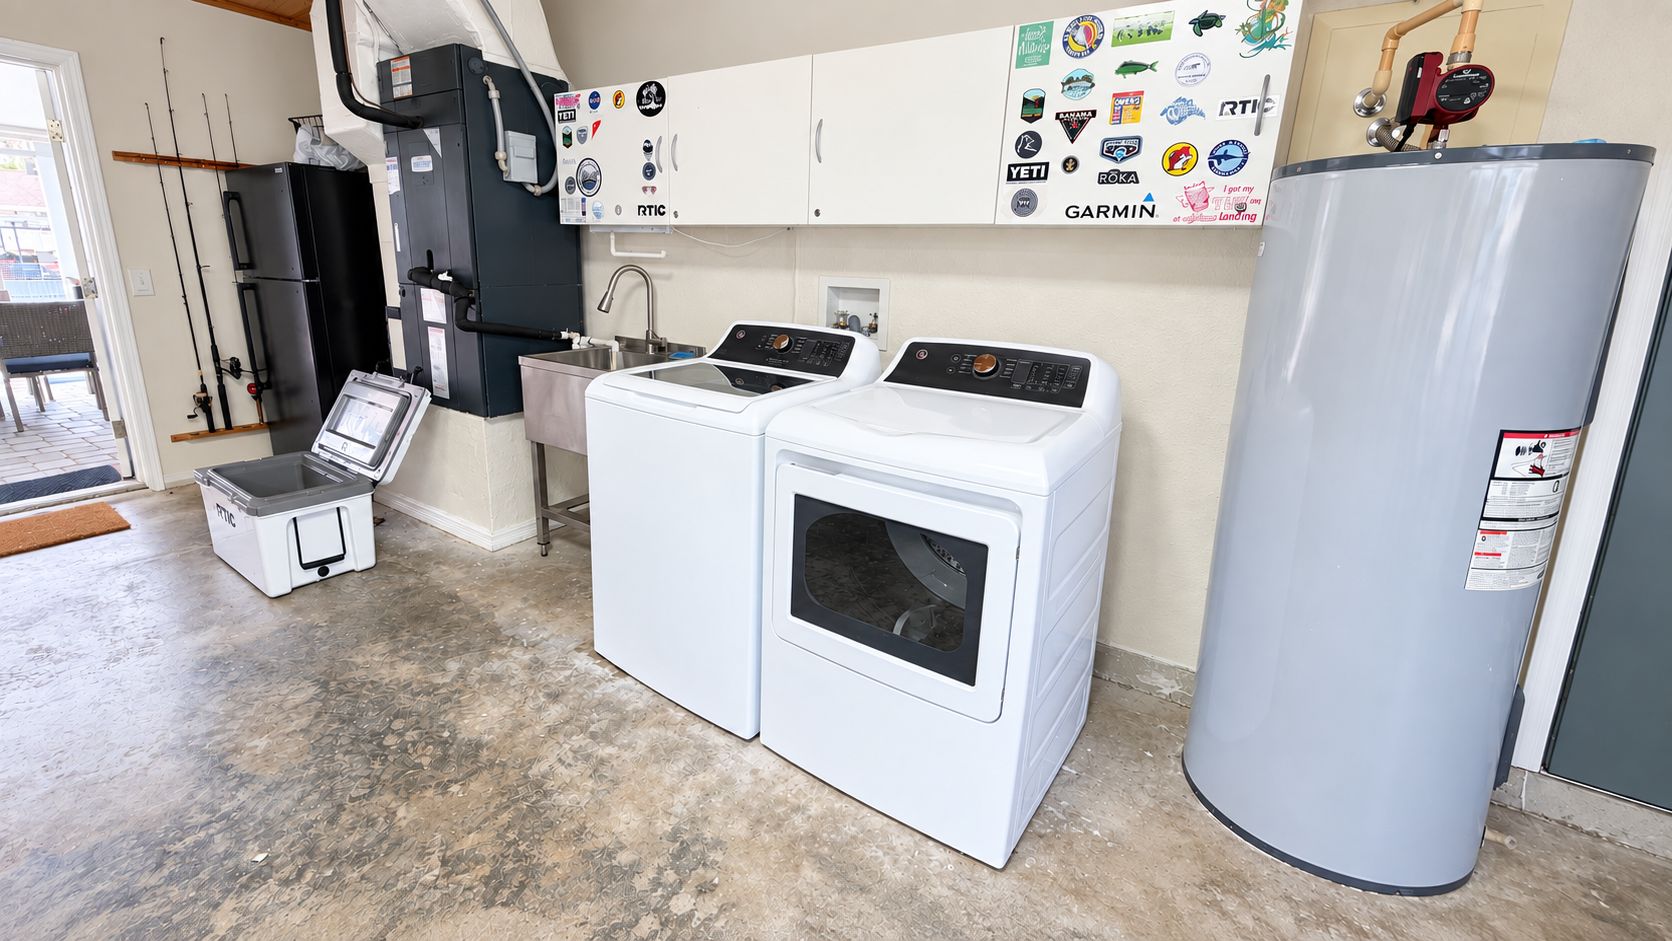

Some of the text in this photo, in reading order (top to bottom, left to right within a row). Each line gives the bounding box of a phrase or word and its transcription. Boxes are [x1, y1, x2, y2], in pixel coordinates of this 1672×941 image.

[558, 111, 575, 120] YETI
[1010, 164, 1046, 179] YETI
[1228, 185, 1241, 195] got
[1242, 186, 1254, 195] my
[637, 204, 667, 217] RTIC
[1065, 204, 1156, 219] GARMIN
[1219, 212, 1257, 223] Landing
[215, 503, 236, 528] RTIC
